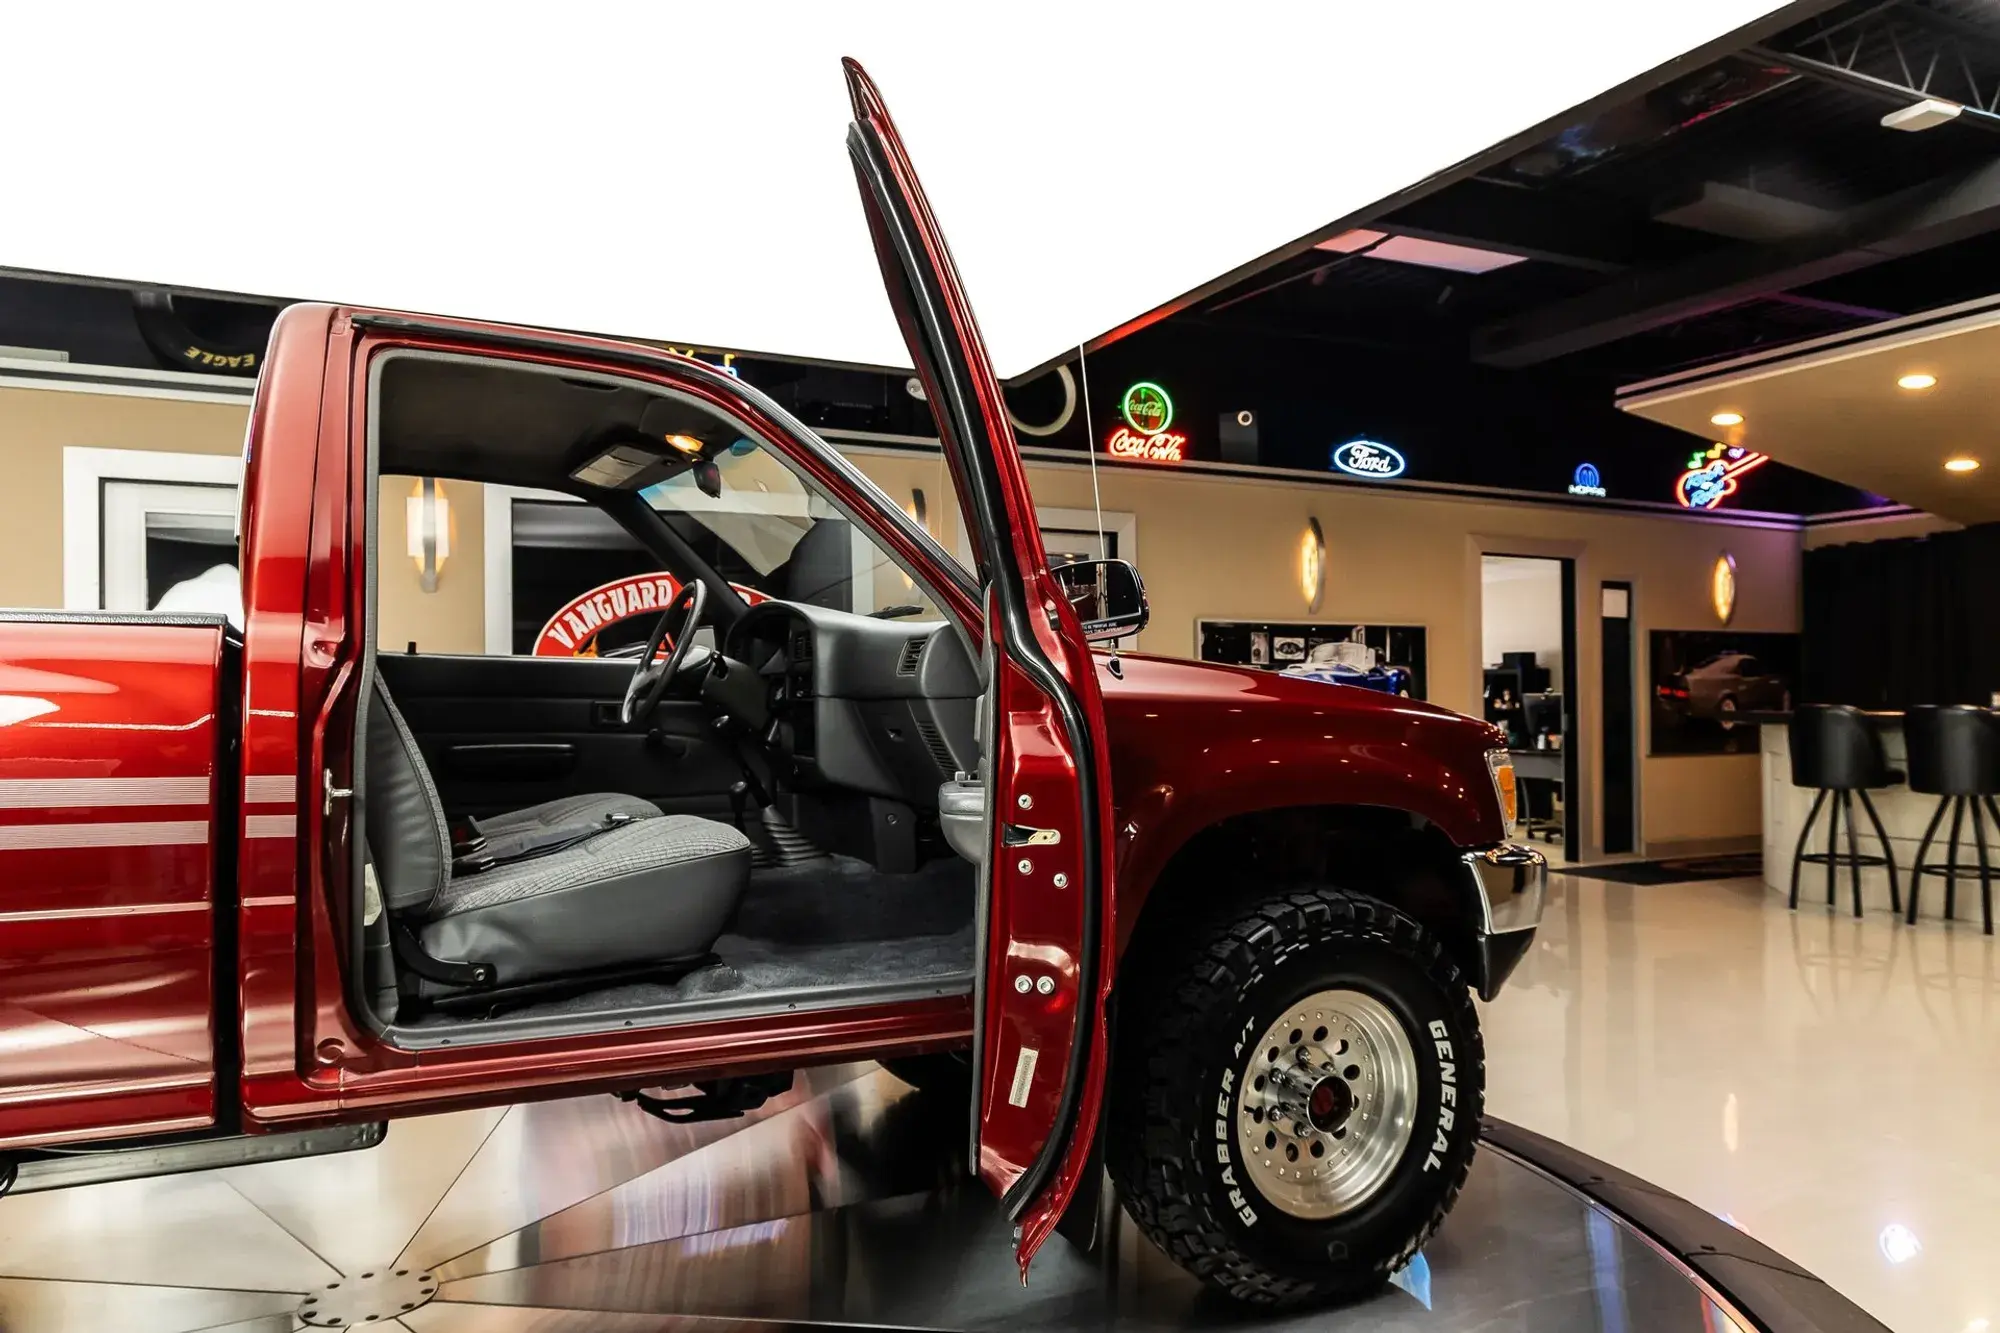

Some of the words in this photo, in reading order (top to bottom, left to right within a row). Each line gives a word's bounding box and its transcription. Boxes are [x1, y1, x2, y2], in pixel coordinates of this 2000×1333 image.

[183, 346, 255, 368] EAGLE
[1348, 443, 1392, 473] Ford
[547, 579, 674, 649] VANGUARD
[1233, 1016, 1255, 1059] A/T
[1422, 1019, 1456, 1173] GENERAL
[1215, 1068, 1258, 1228] GRABBER
